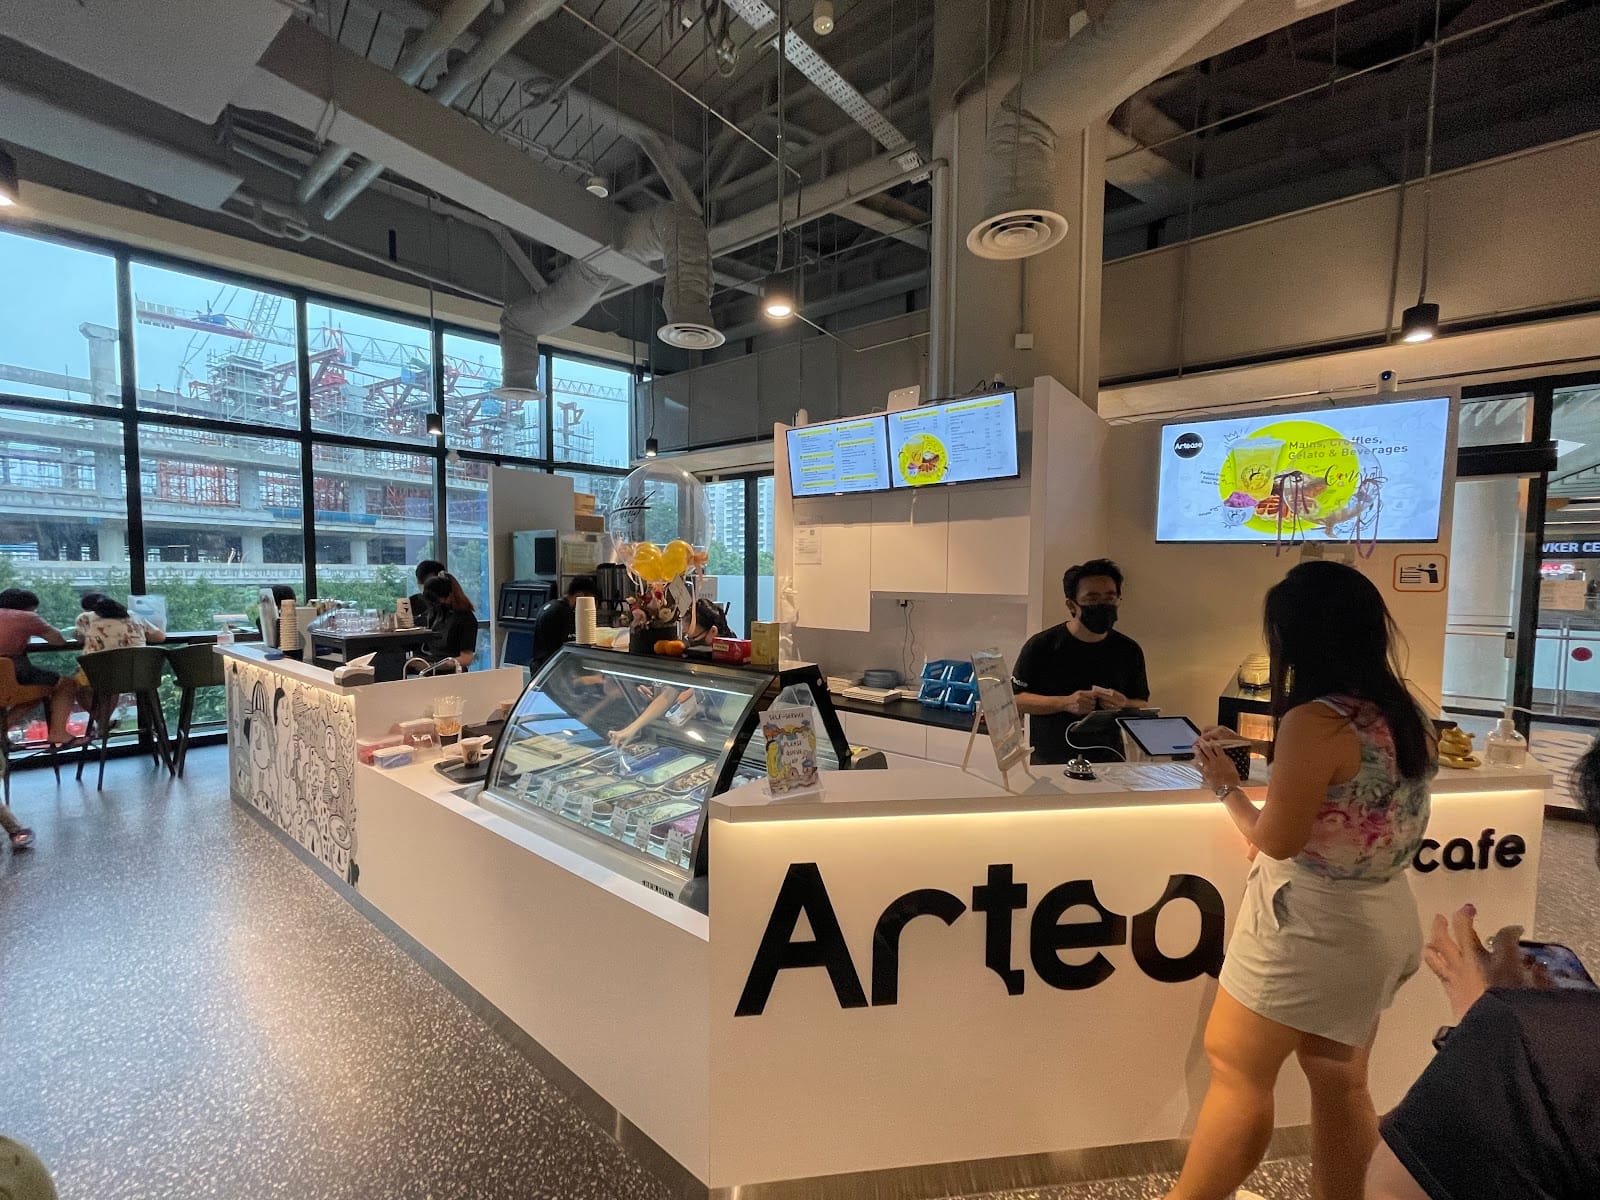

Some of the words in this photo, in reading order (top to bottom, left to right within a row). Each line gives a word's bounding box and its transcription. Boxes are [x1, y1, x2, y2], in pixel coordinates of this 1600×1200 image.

[1289, 441, 1326, 450] Mains,
[1288, 450, 1325, 460] Gelato
[1329, 449, 1336, 457] &
[1341, 445, 1409, 456] Beverages
[1582, 542, 1600, 553] CE
[1412, 828, 1526, 873] cafe
